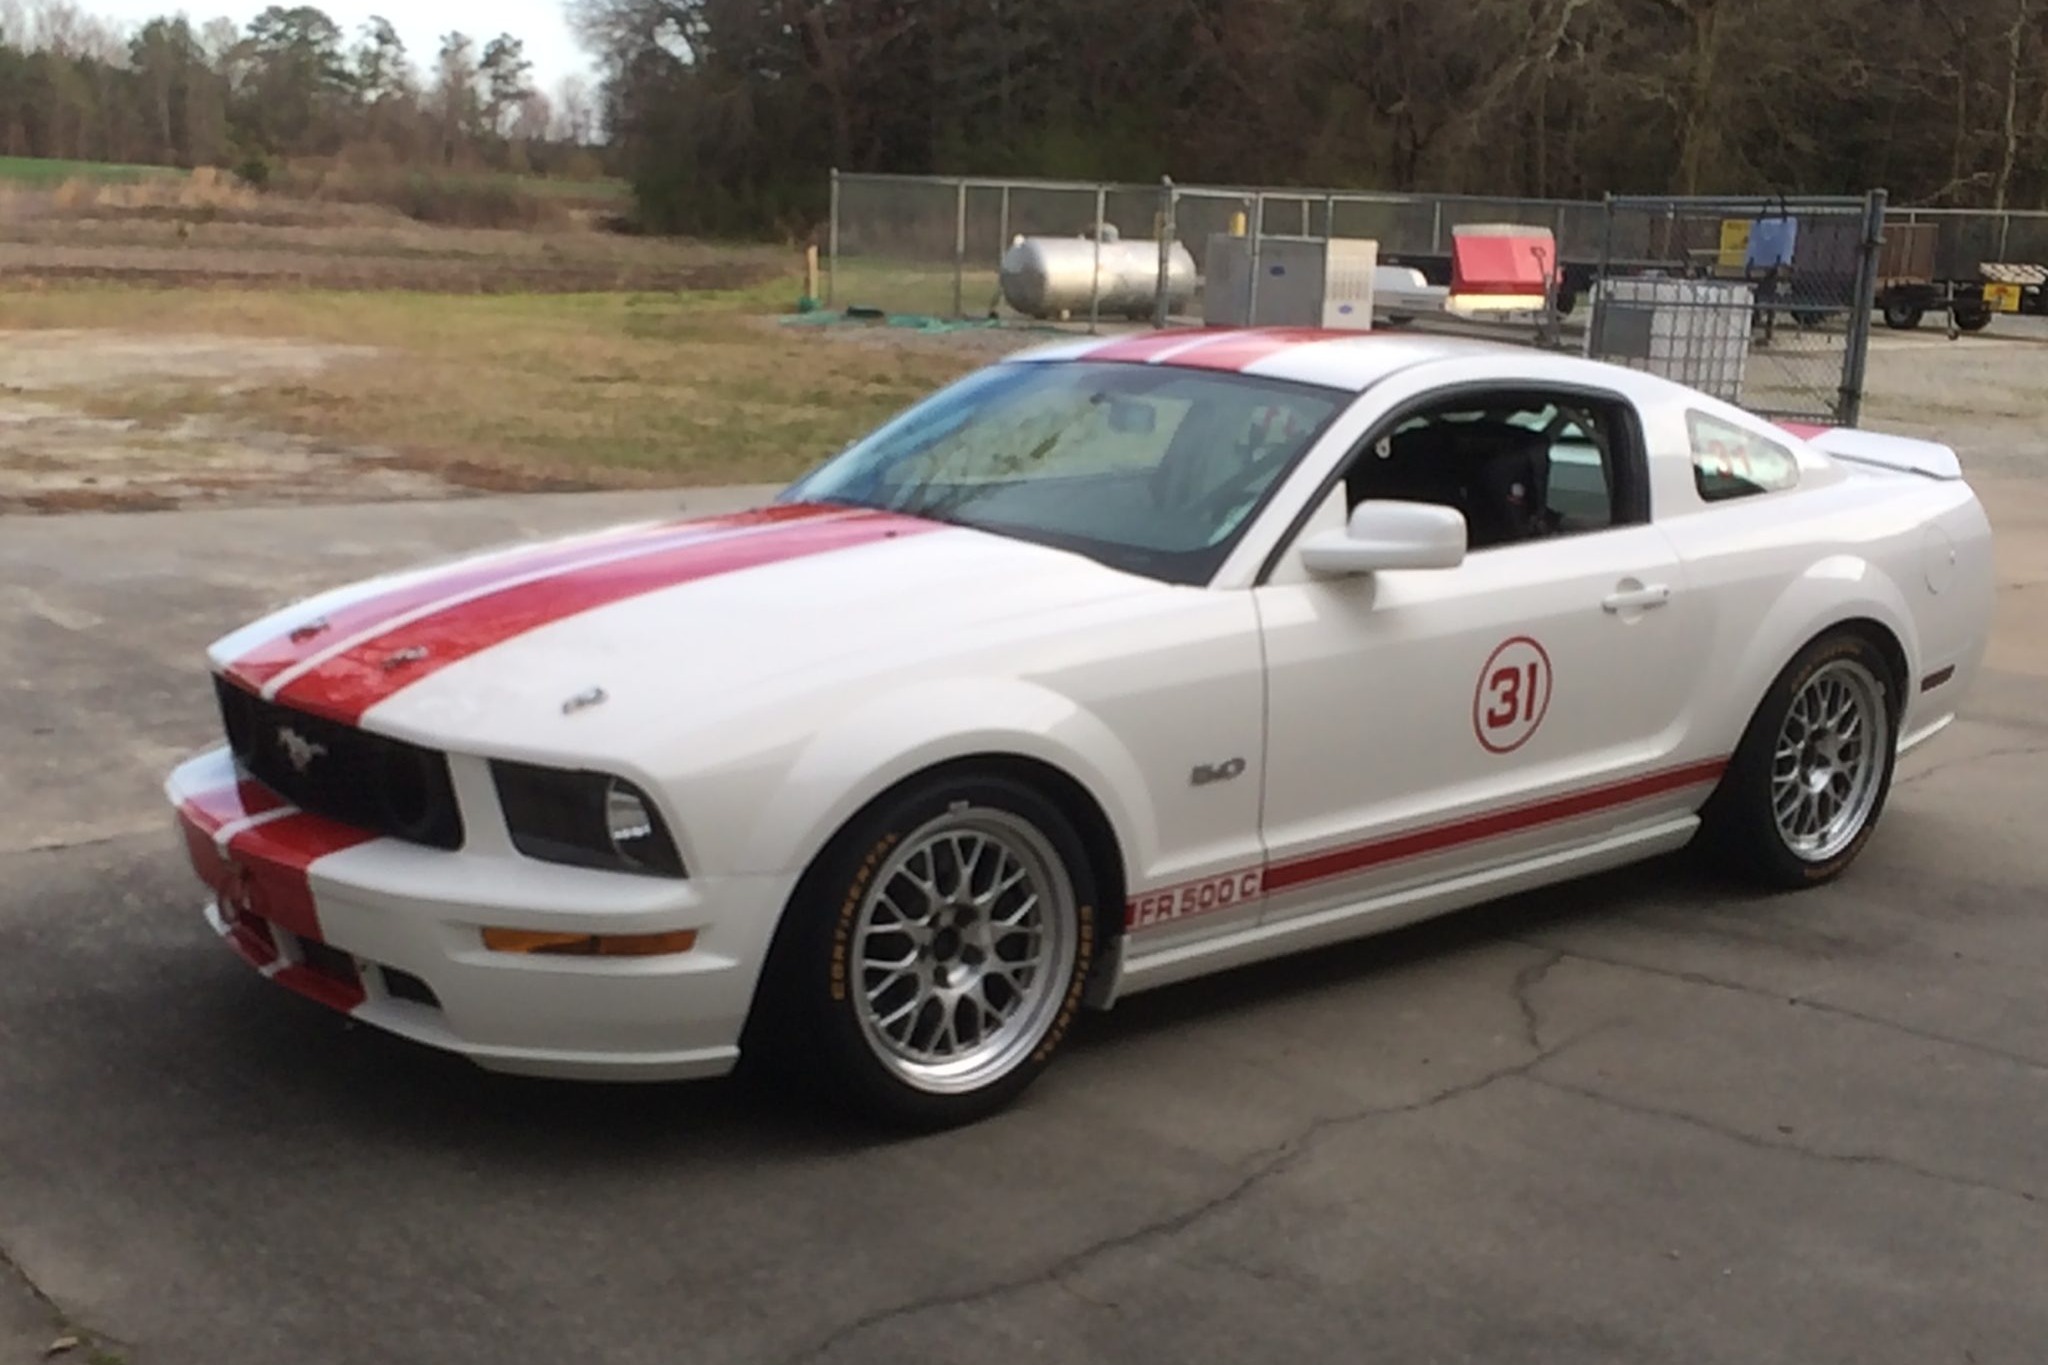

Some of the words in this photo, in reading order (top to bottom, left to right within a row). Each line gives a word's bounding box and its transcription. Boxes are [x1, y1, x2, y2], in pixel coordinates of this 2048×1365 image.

[1487, 662, 1538, 729] 31
[1139, 894, 1175, 926] FR
[1180, 878, 1235, 913] 500
[1240, 873, 1258, 898] C
